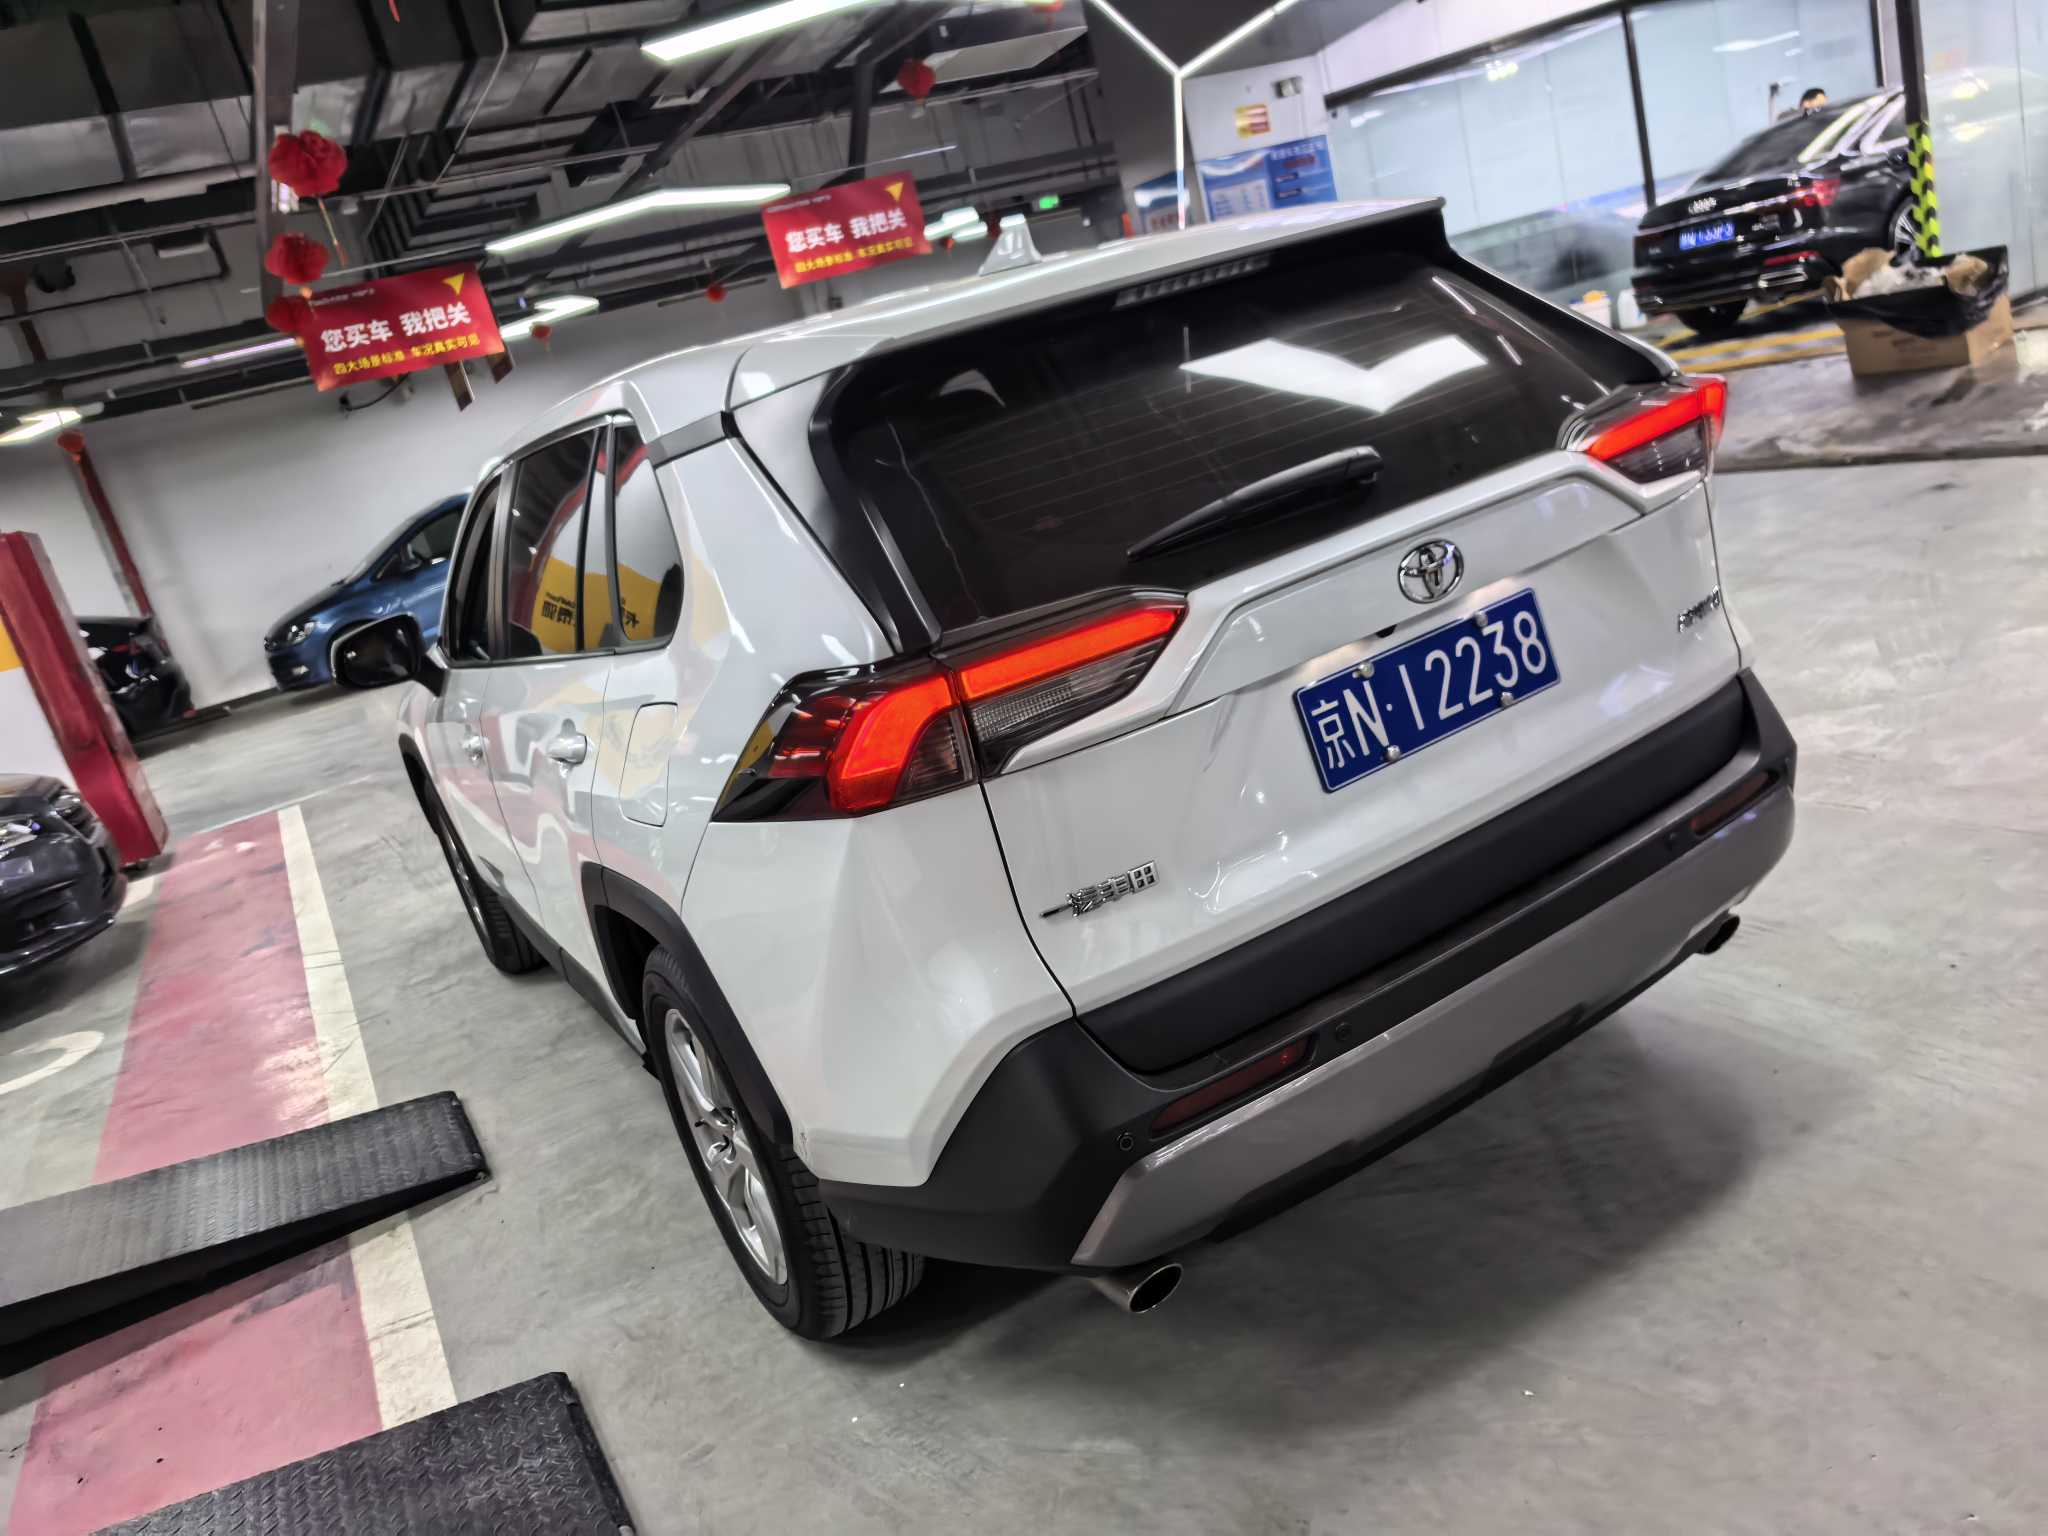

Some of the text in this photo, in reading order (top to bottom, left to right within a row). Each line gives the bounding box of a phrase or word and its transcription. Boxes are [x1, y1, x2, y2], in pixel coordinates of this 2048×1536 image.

[785, 223, 845, 253] 您买车
[849, 207, 907, 239] 我把关
[321, 302, 471, 352] 您买车 我把关
